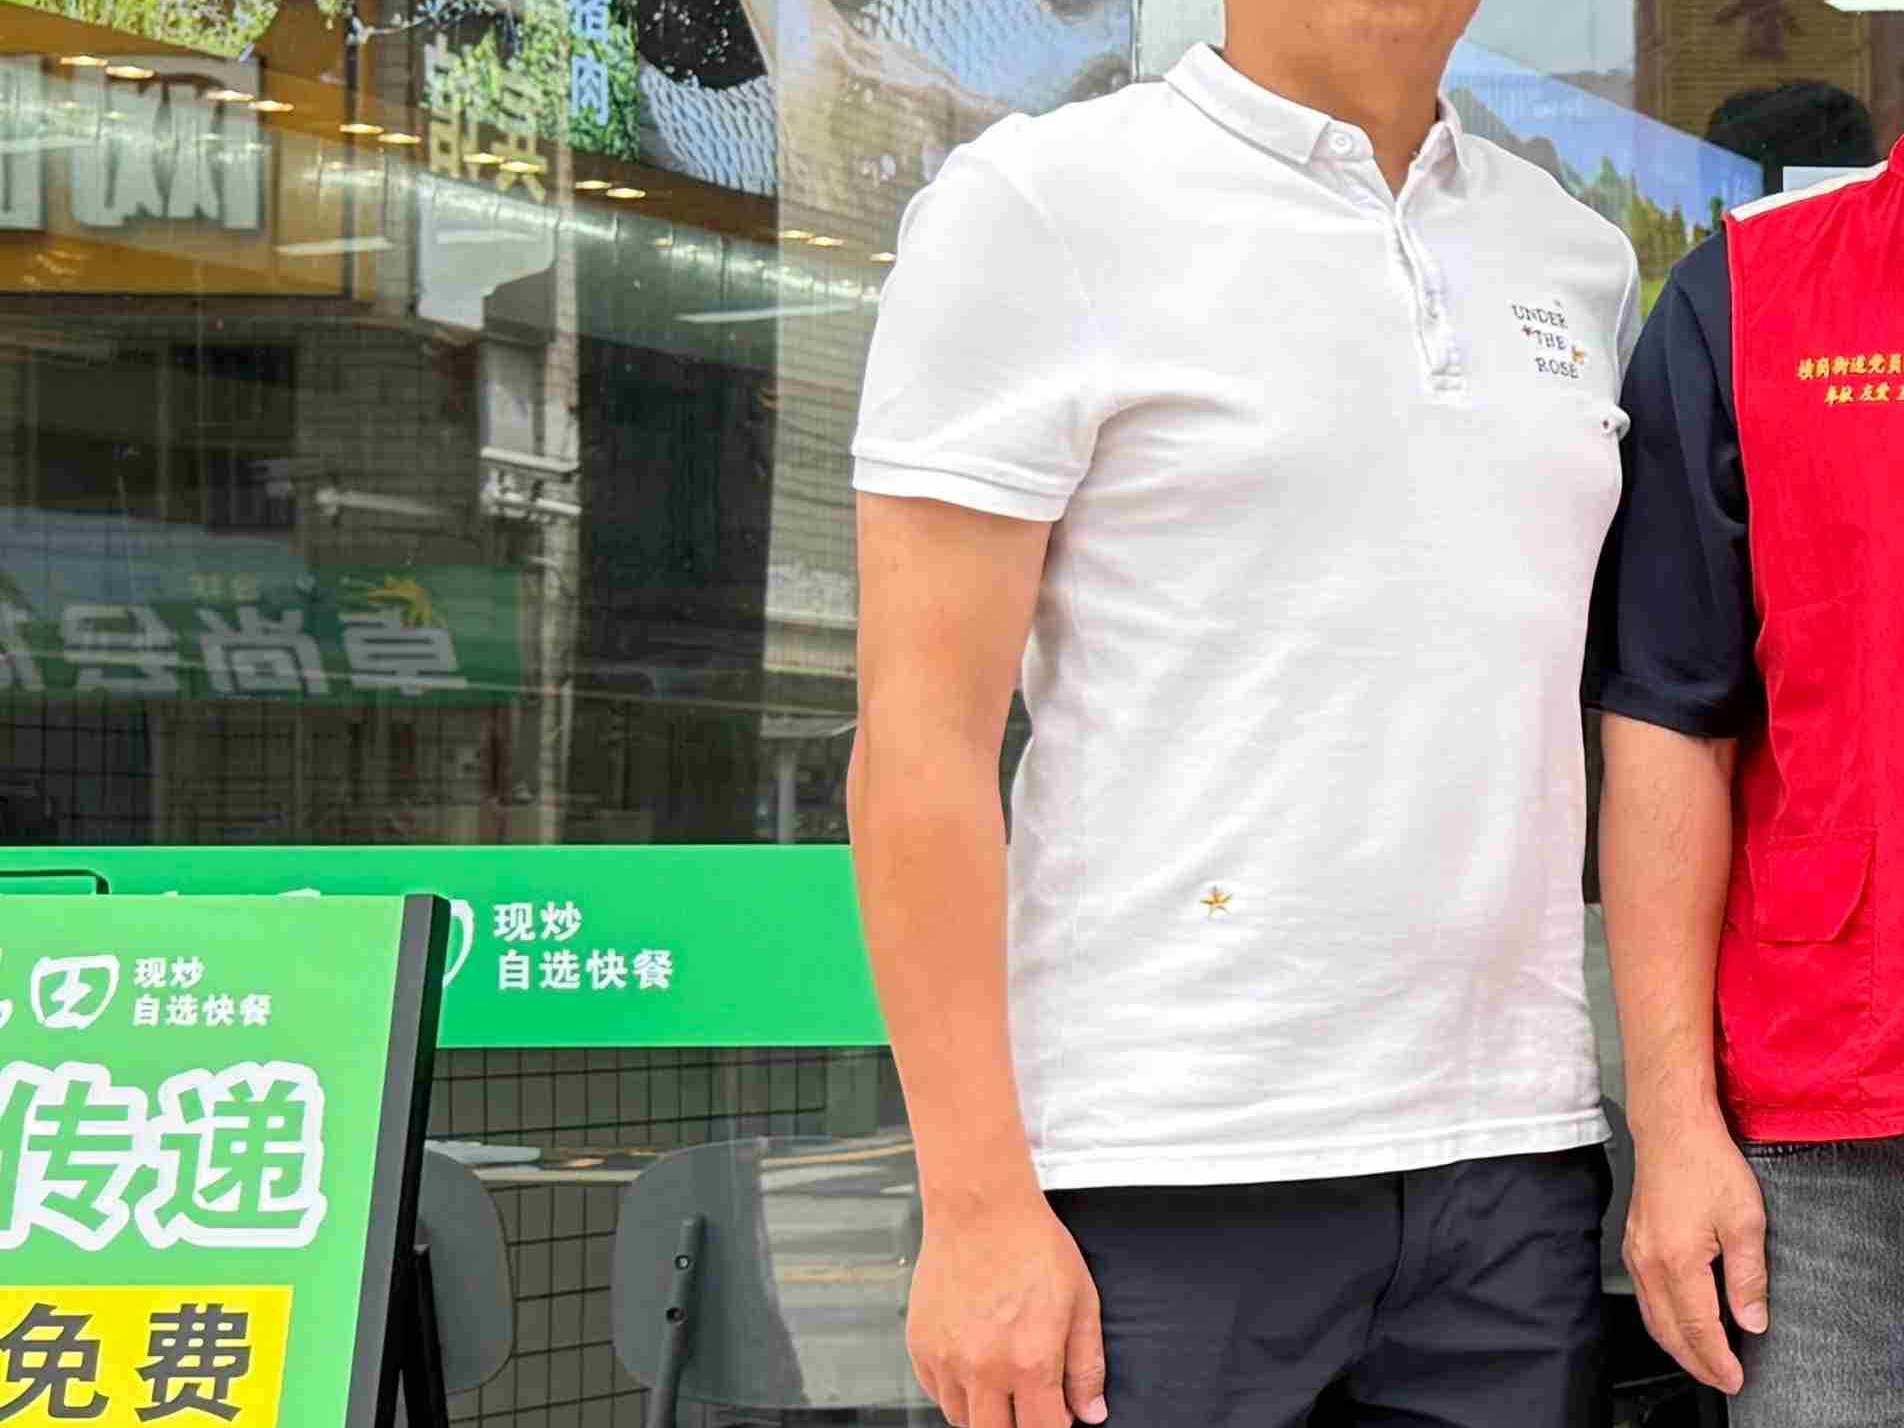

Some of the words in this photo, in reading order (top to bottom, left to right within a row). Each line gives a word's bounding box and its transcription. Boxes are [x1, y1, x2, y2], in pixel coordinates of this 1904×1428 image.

[1511, 304, 1568, 330] UNDER
[1533, 329, 1567, 350] THE
[1534, 357, 1580, 379] ROSE
[494, 901, 583, 943] 现炒
[133, 956, 205, 988] 现炒
[497, 948, 675, 991] 自选快餐
[133, 993, 272, 1028] 自选快餐
[0, 1303, 252, 1421] 免费
